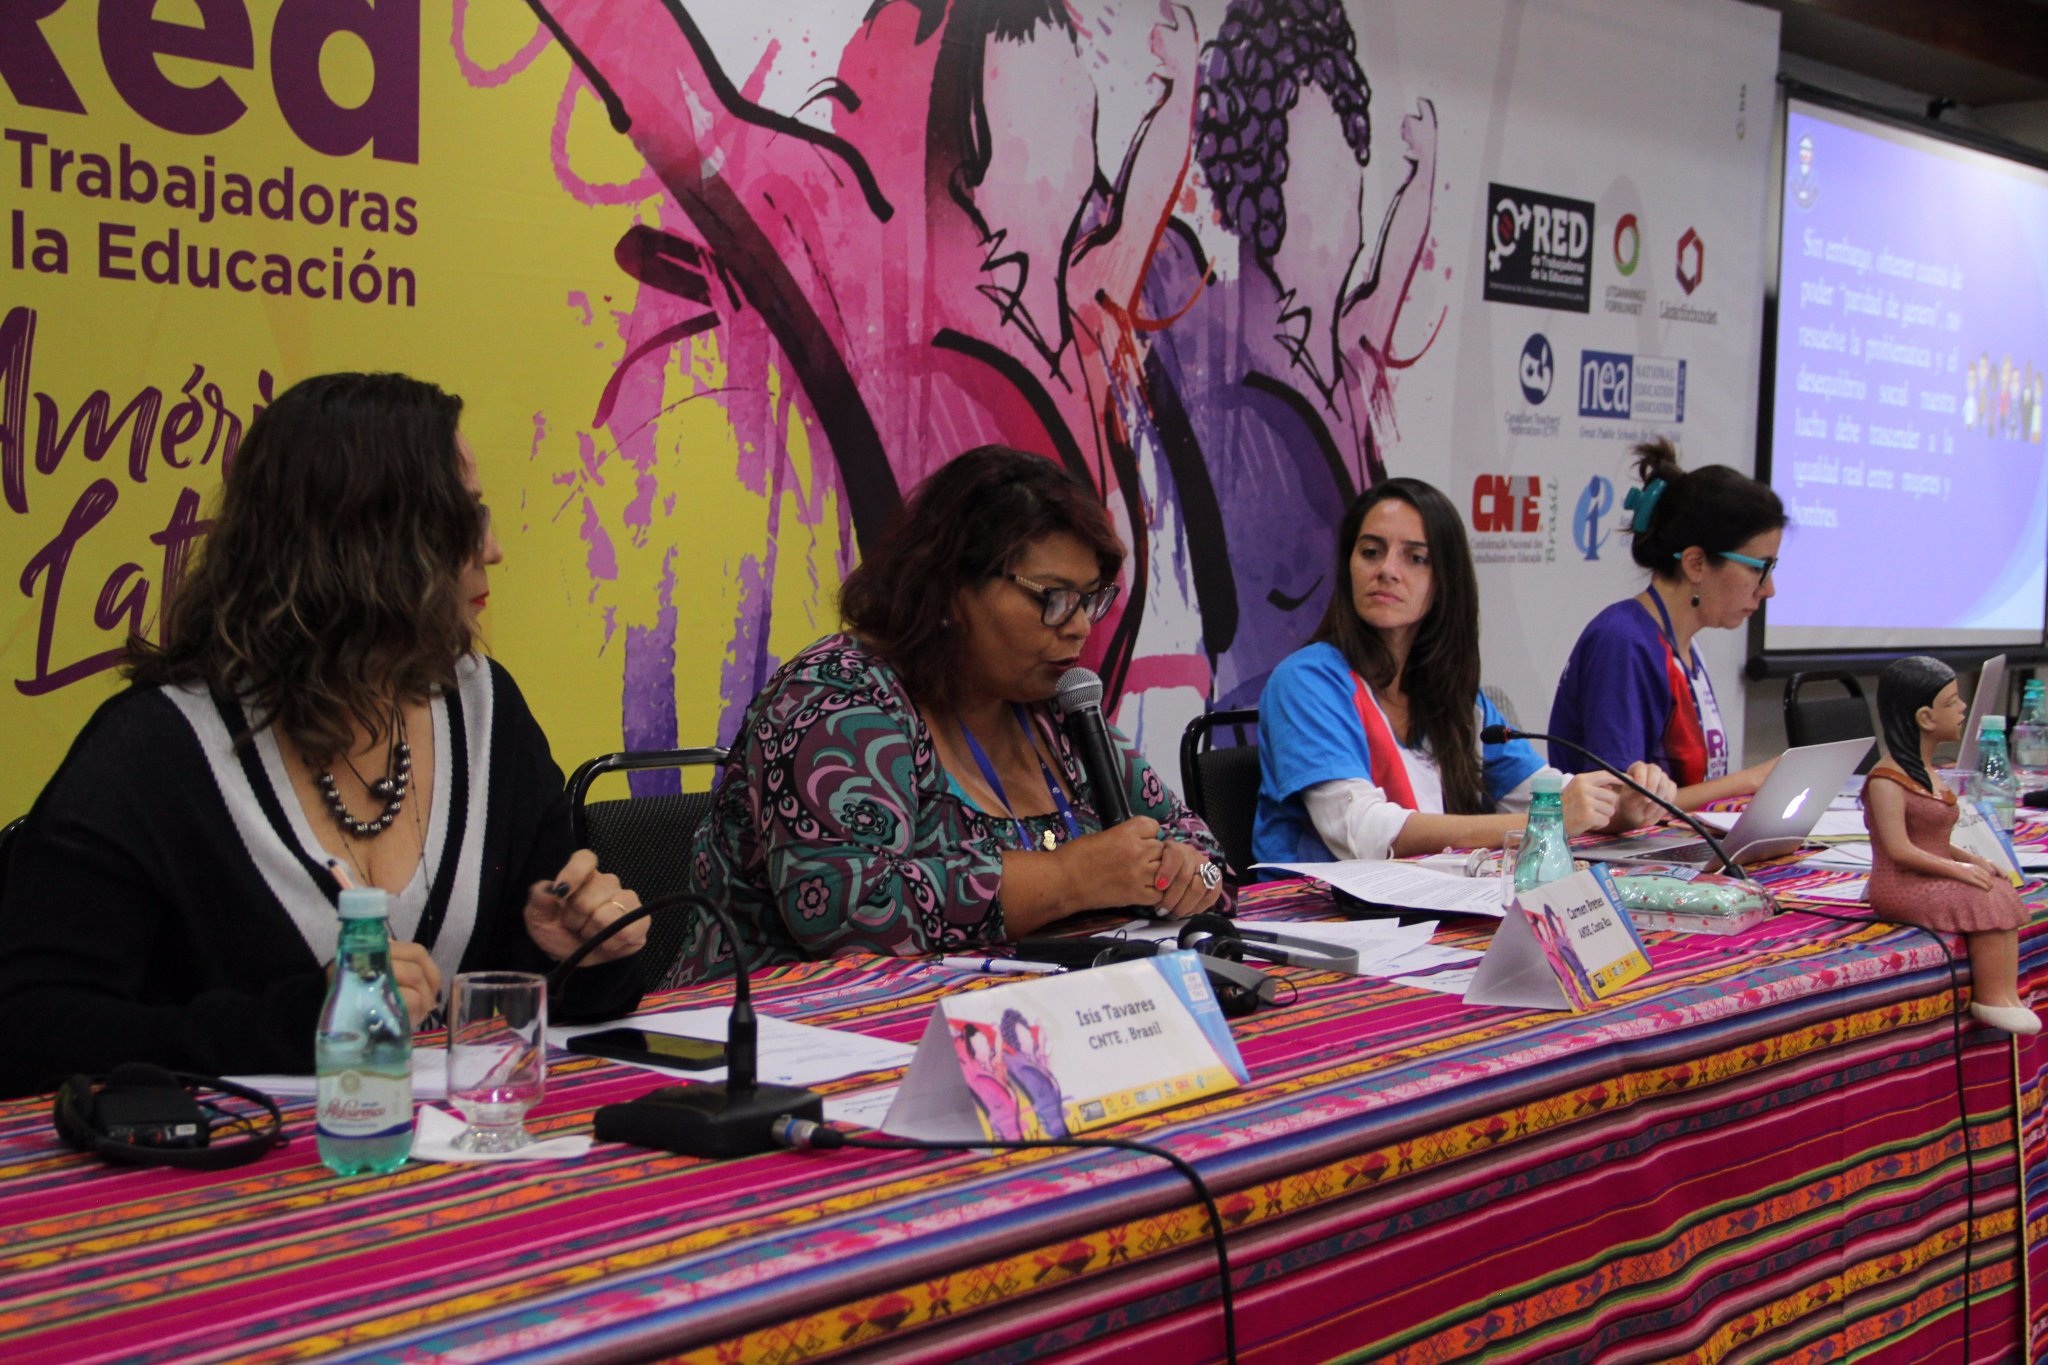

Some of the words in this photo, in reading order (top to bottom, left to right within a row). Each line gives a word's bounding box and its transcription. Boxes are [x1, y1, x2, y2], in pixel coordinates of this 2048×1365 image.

[4, 128, 419, 236] Trabajadoras
[11, 210, 69, 275] la
[98, 221, 416, 308] Educación
[1532, 204, 1588, 258] RED
[1581, 360, 1630, 413] nea
[1472, 474, 1541, 533] CNTE
[14, 478, 214, 696] Lat
[1075, 1007, 1102, 1028] Isis
[1103, 997, 1156, 1025] Tavares
[1130, 1022, 1162, 1042] Brasil
